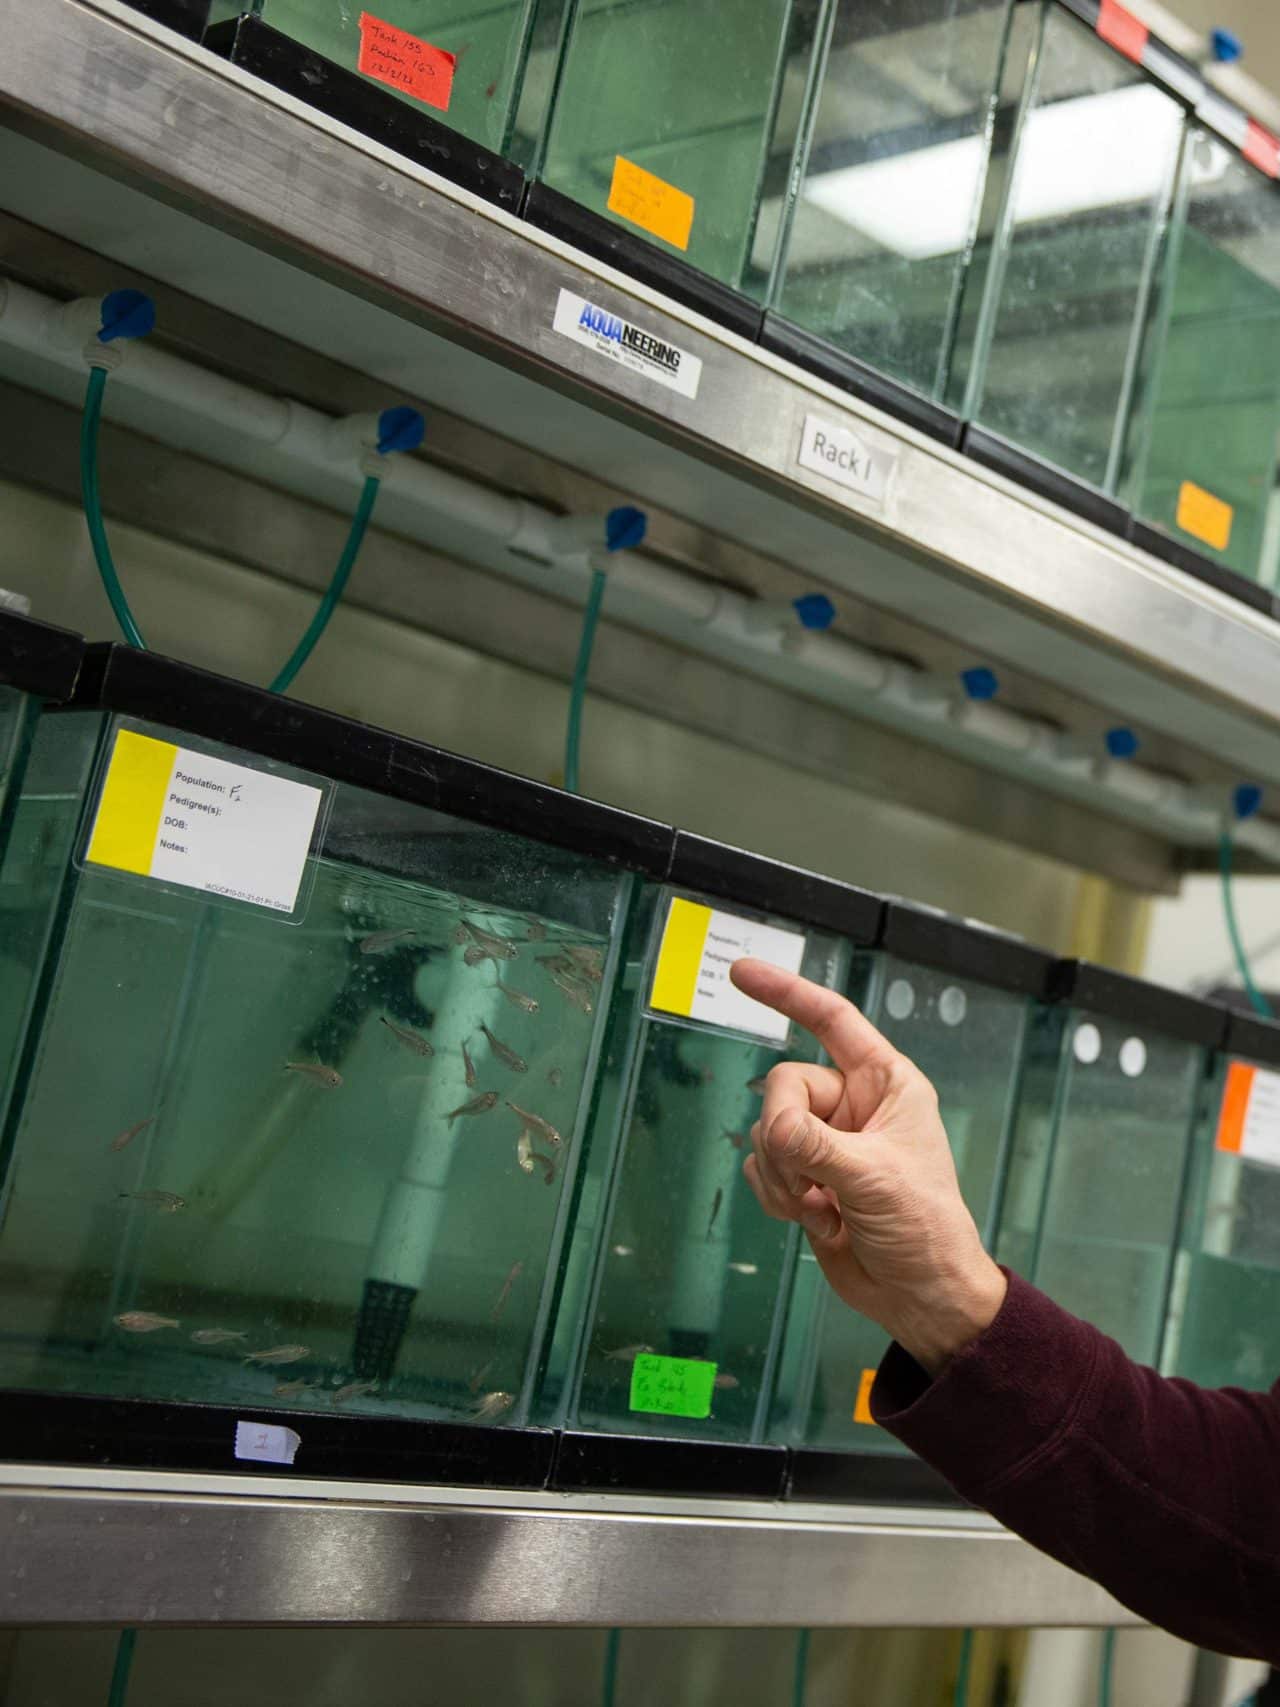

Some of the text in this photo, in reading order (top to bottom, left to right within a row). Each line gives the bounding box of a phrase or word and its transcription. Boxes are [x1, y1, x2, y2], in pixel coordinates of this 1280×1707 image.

[371, 25, 397, 42] Tank
[579, 303, 681, 368] AQUANEERING
[813, 431, 859, 476] Rack
[175, 771, 226, 793] Population:
[169, 793, 222, 816] Pedigree(s):
[164, 815, 189, 830] DOB:
[160, 838, 189, 854] Notes:
